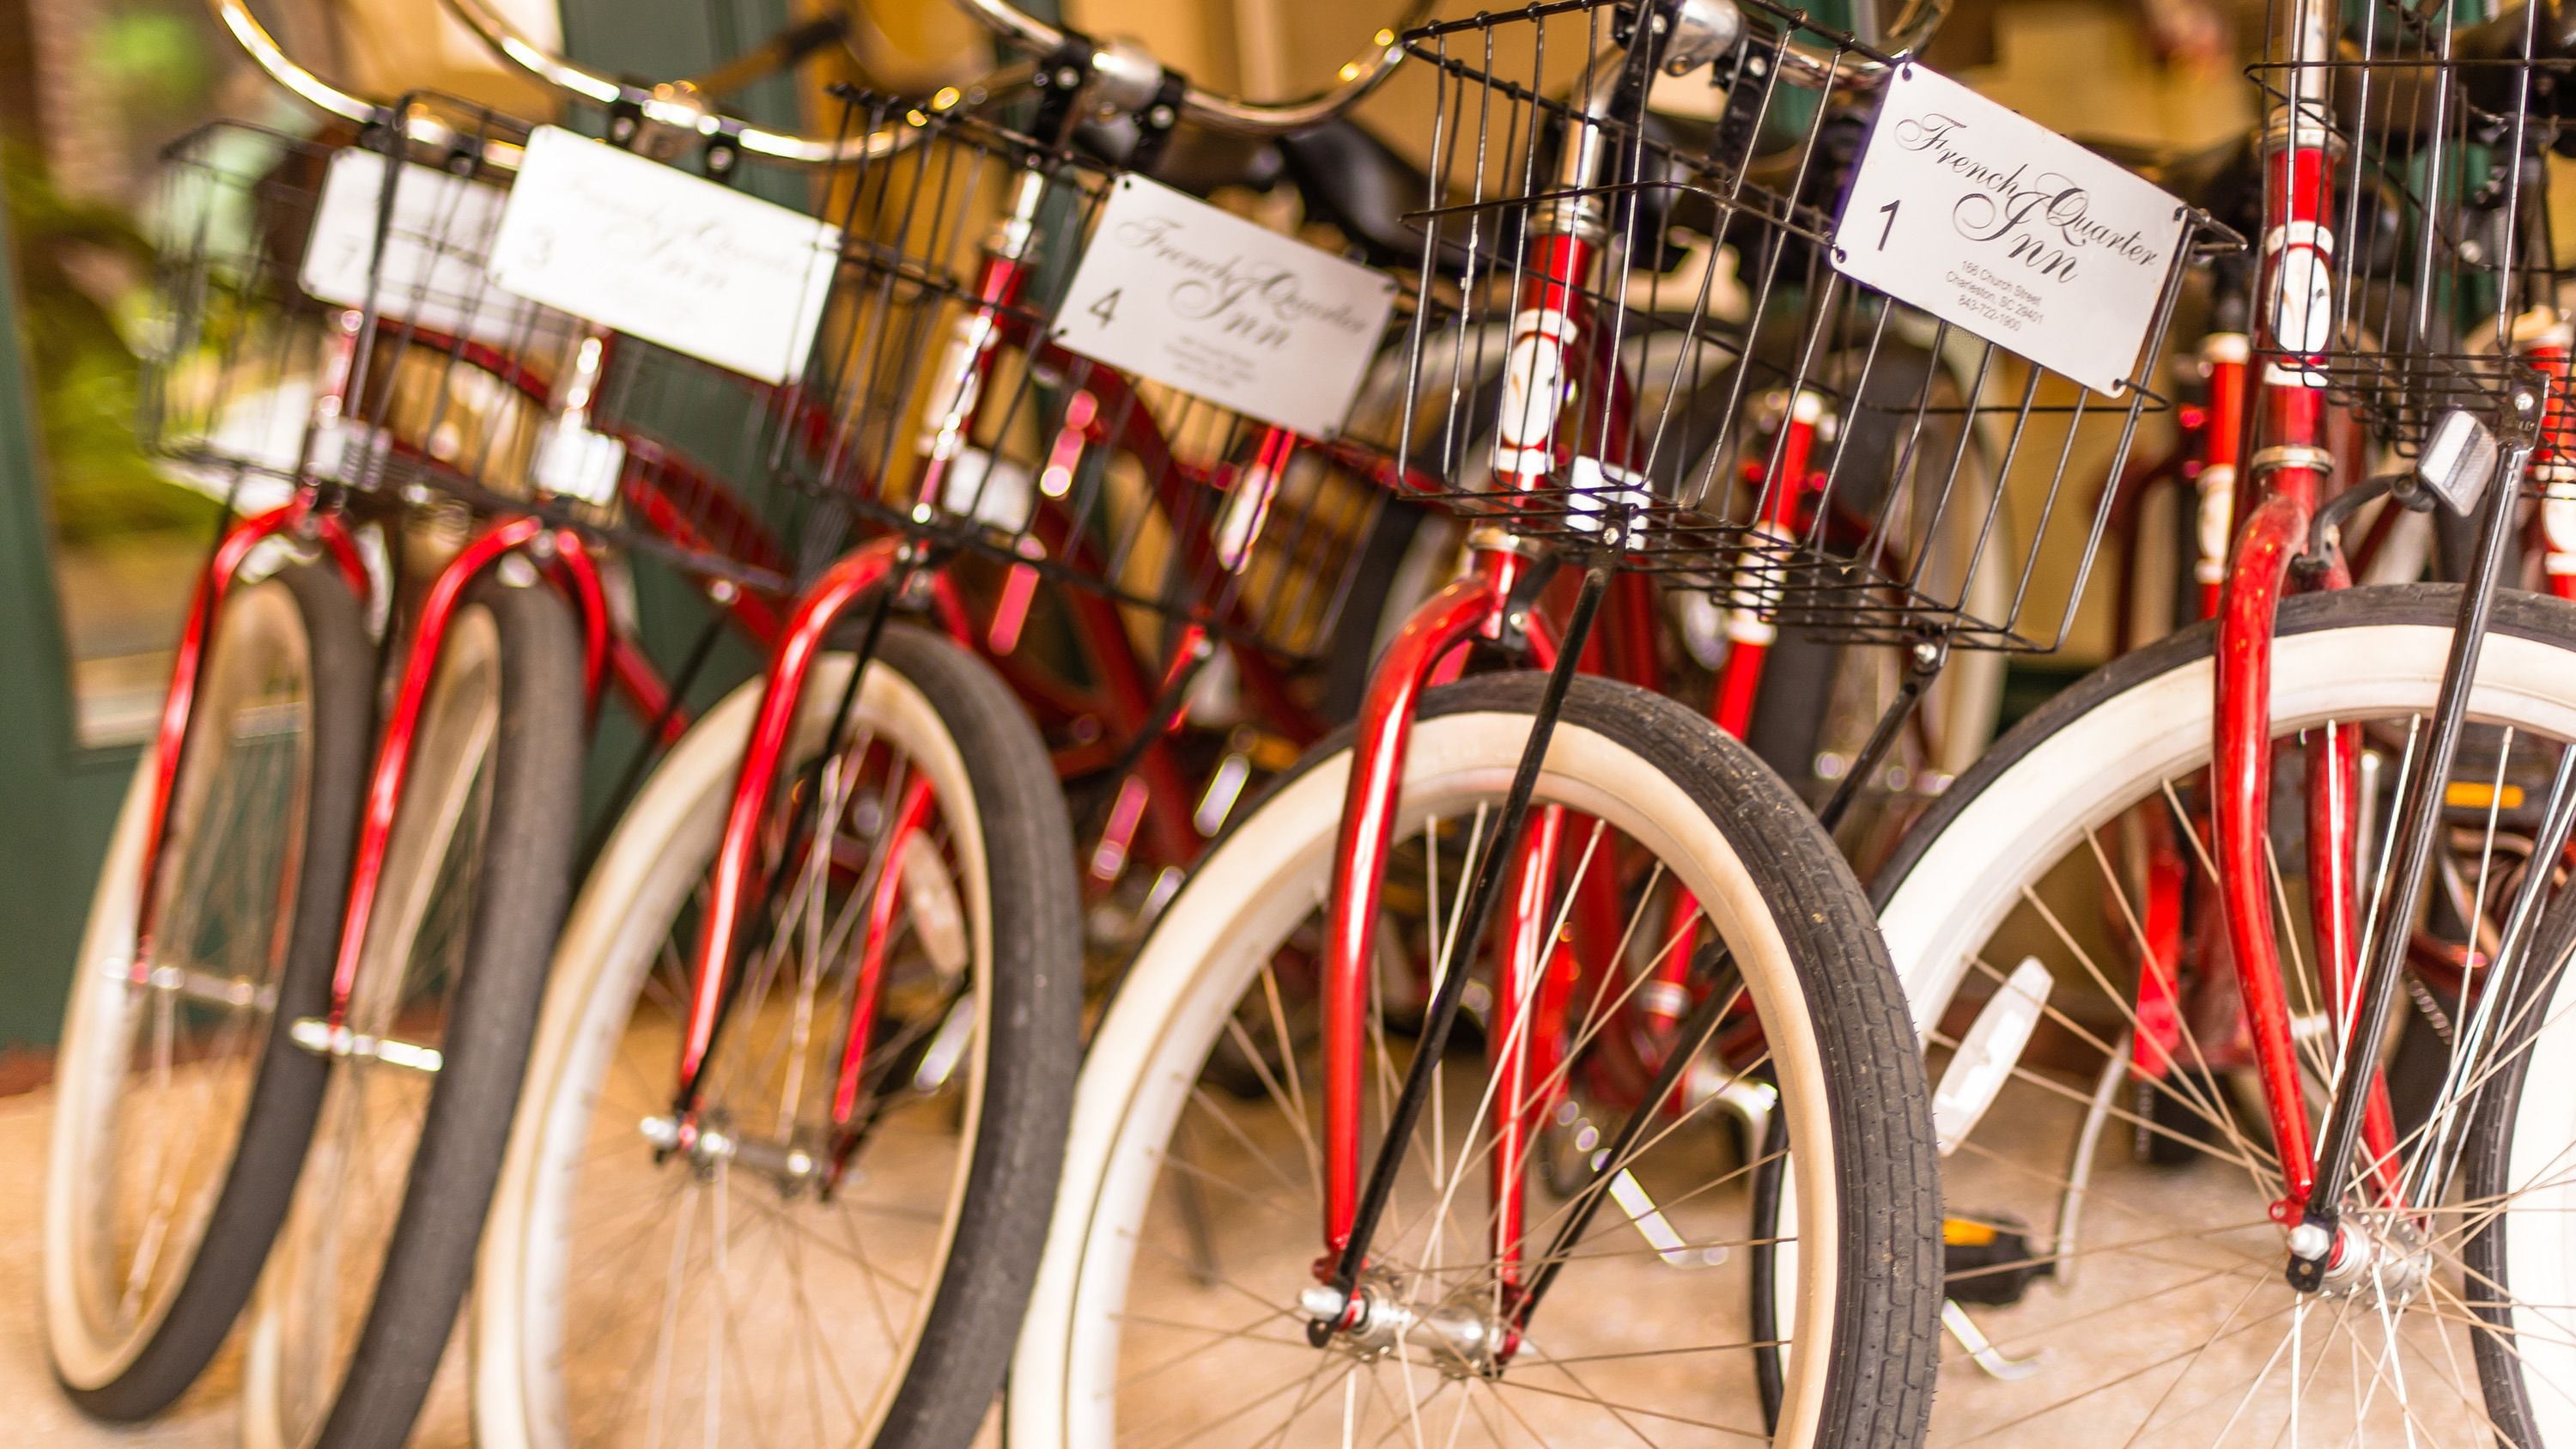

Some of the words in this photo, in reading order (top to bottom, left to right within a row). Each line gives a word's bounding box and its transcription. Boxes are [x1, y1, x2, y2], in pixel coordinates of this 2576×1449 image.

[1879, 199, 1901, 252] 1
[1895, 113, 2027, 198] French
[2035, 173, 2158, 266] Quarter
[1953, 191, 2078, 283] Inn
[1089, 289, 1122, 328] 4
